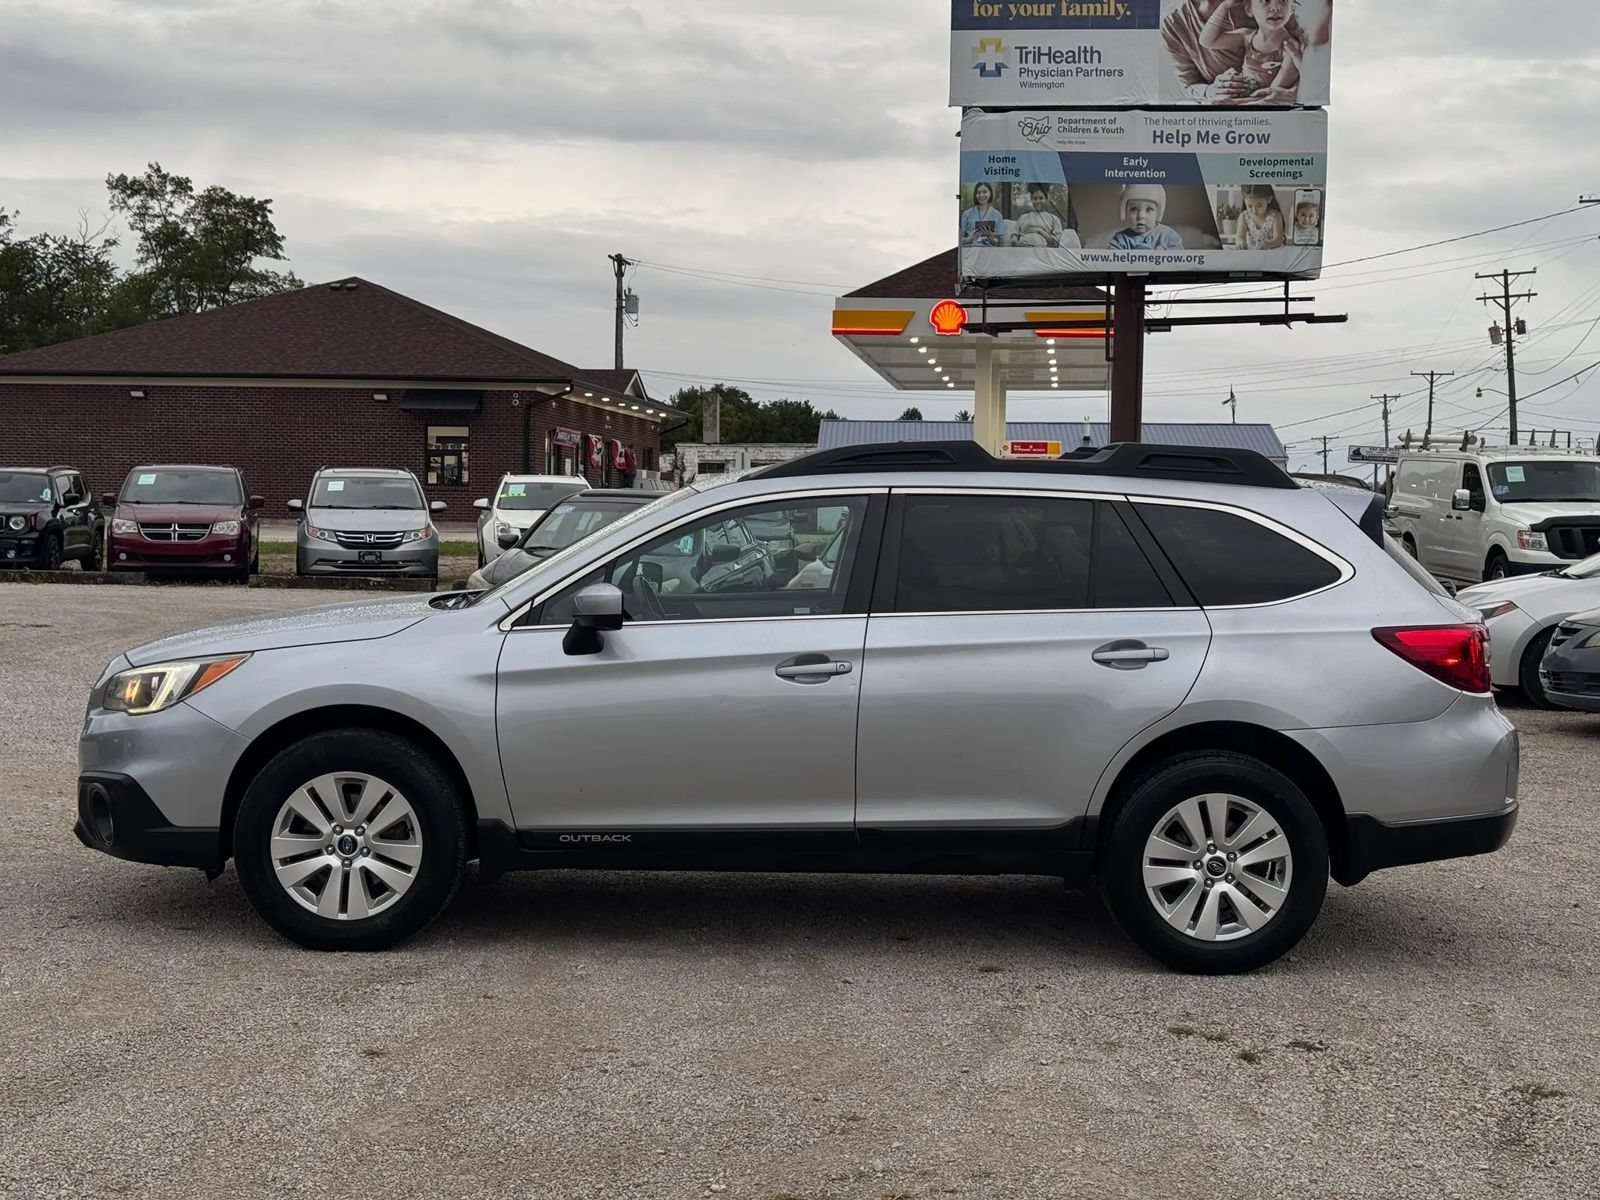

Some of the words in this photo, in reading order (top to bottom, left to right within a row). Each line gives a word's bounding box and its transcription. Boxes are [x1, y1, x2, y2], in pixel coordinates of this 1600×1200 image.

[973, 0, 1002, 17] for
[1009, 2, 1056, 21] your
[1061, 0, 1132, 20] family.
[1014, 46, 1101, 65] TriHealth
[1019, 67, 1073, 80] Physician
[1075, 67, 1124, 78] Partners
[1019, 81, 1065, 90] Wilmington
[1057, 117, 1107, 127] Department
[1108, 117, 1117, 125] of
[1144, 117, 1160, 126] The
[1162, 117, 1186, 126] heart
[1187, 117, 1197, 126] of
[1198, 117, 1233, 128] thriving
[1234, 117, 1272, 126] families.
[1018, 120, 1052, 137] Ohio
[1101, 126, 1124, 134] Youth
[1152, 129, 1192, 147] Help
[1196, 130, 1221, 144] Me
[1225, 130, 1271, 144] Grow
[988, 154, 1017, 163] Home
[1123, 157, 1149, 168] Early
[1239, 157, 1313, 168] Developmental
[983, 166, 1021, 177] Visiting
[1104, 168, 1166, 178] Intervention
[1249, 169, 1303, 180] Screenings
[1080, 252, 1205, 265] www.helpmegrow.org
[559, 834, 632, 842] OUTBACK
